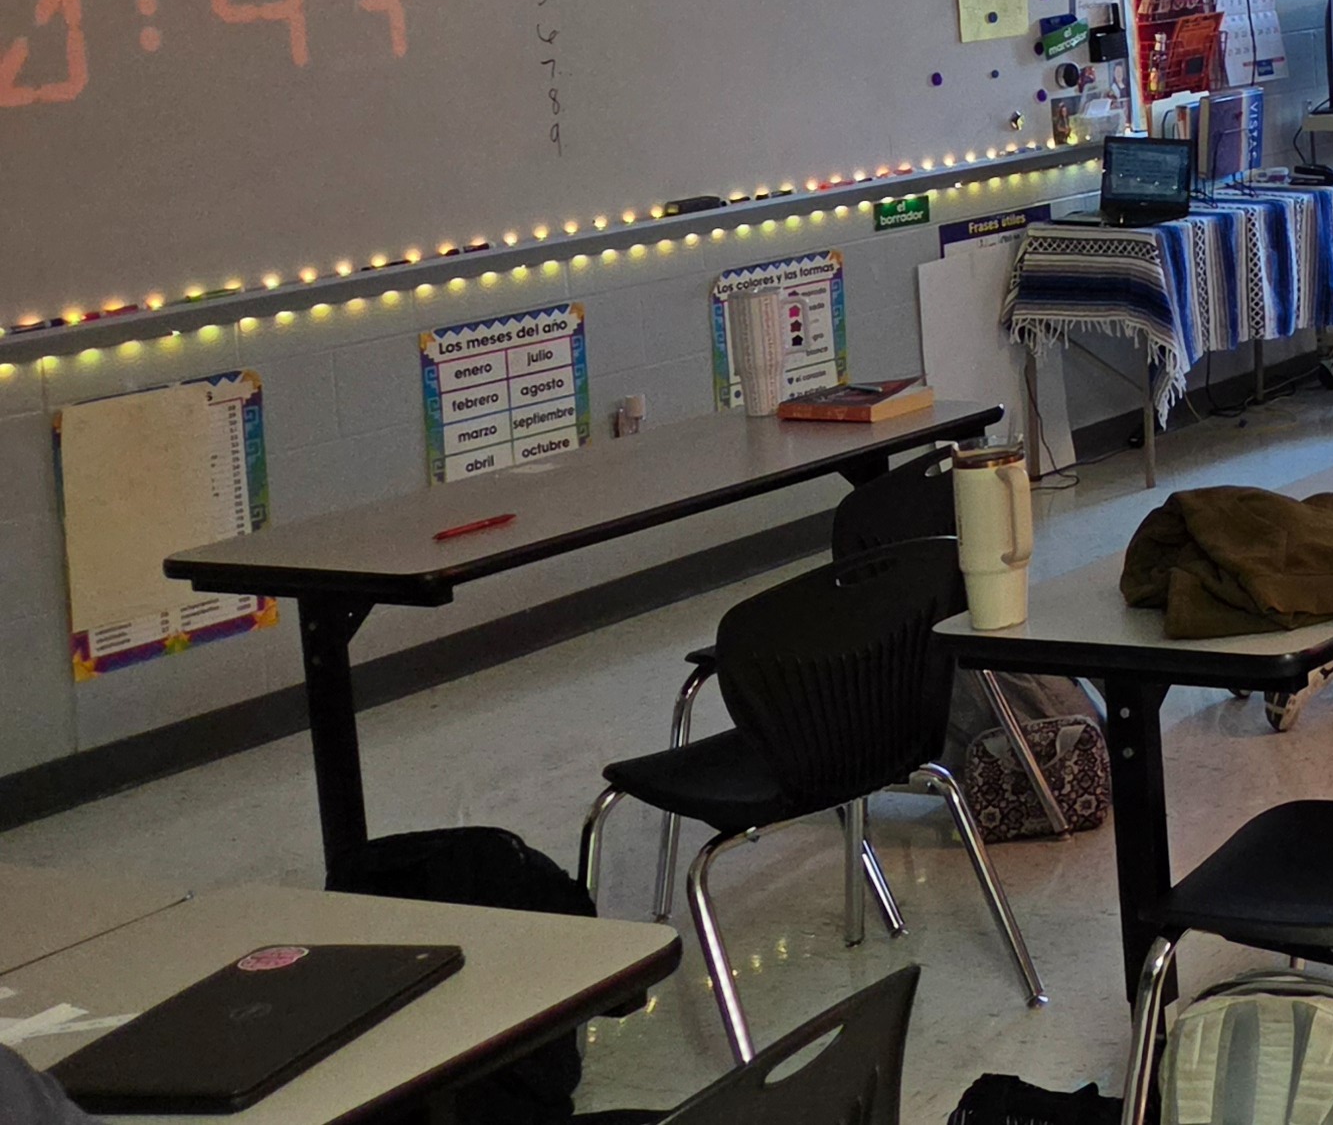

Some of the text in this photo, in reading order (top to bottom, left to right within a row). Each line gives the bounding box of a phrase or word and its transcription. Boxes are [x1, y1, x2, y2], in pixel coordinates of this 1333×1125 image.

[1049, 31, 1087, 55] marcador
[1064, 27, 1072, 38] el
[880, 210, 924, 225] borrador
[897, 201, 906, 212] el
[969, 217, 999, 234] Frases
[717, 262, 835, 295] Los colores y las formas
[439, 319, 568, 355] Los meses del año
[454, 349, 554, 379] enero julio
[452, 378, 565, 412] febrero agosto
[457, 406, 575, 443] marzo septiembre
[465, 437, 570, 472] abril octubre
